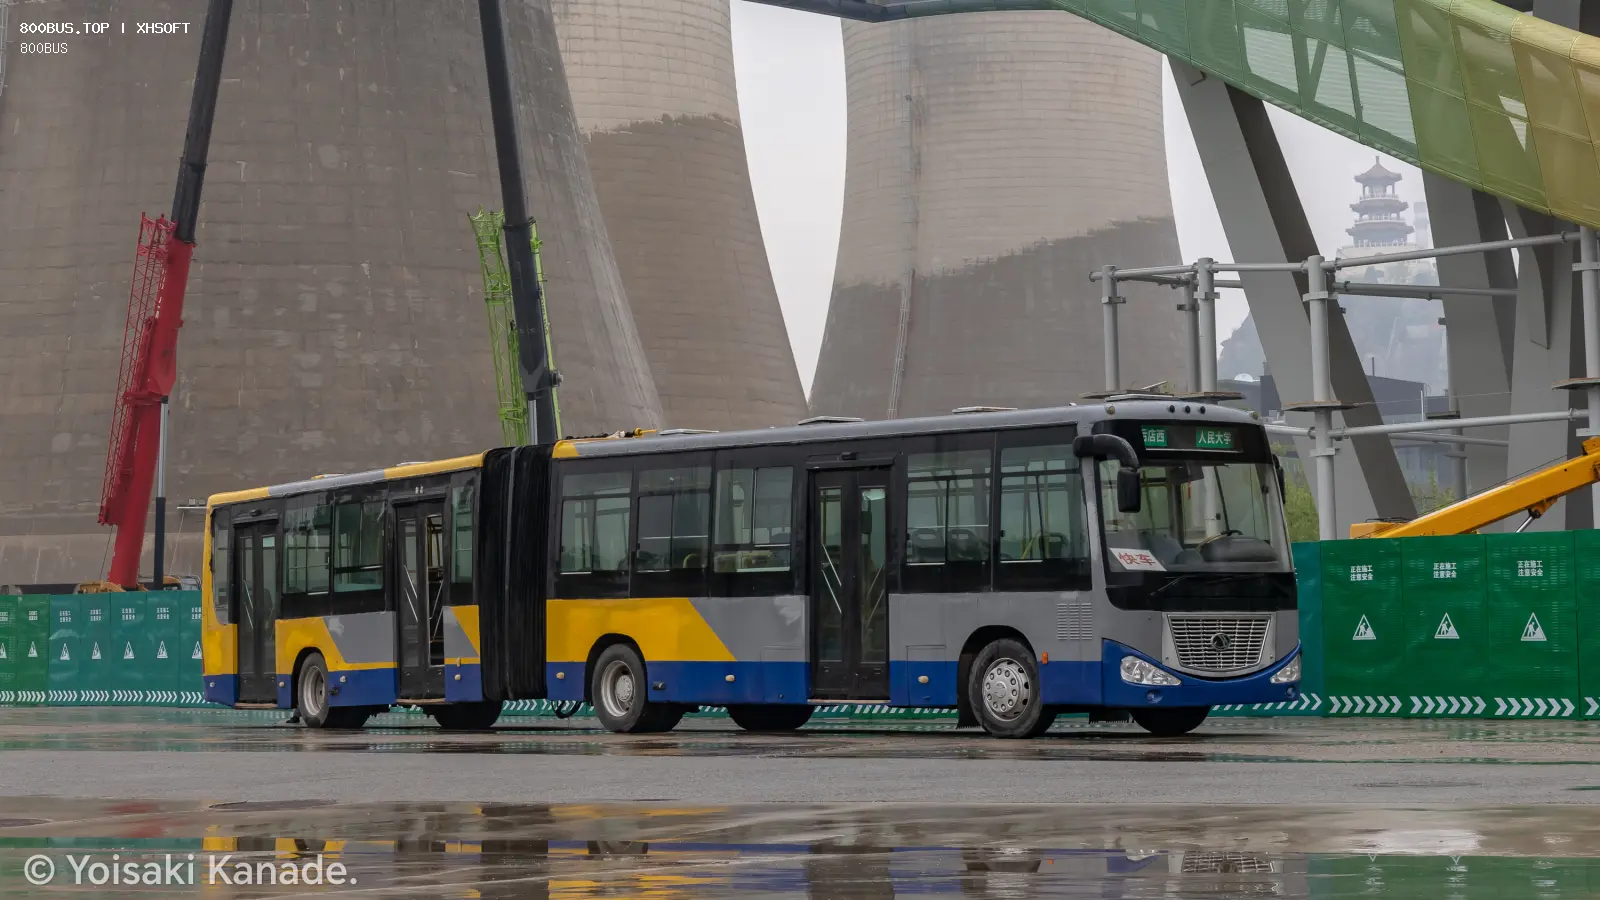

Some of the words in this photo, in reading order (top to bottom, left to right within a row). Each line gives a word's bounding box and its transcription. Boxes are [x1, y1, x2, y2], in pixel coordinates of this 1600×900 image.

[1198, 430, 1232, 445] 人民大学
[1118, 552, 1156, 566] 快车
[1350, 565, 1373, 573] 正在施工
[1433, 562, 1457, 571] 正在施工
[1517, 560, 1543, 569] 正在施工
[1350, 573, 1374, 581] 注意安全
[1433, 570, 1457, 579] 注意安全
[1517, 568, 1543, 577] 注意安全
